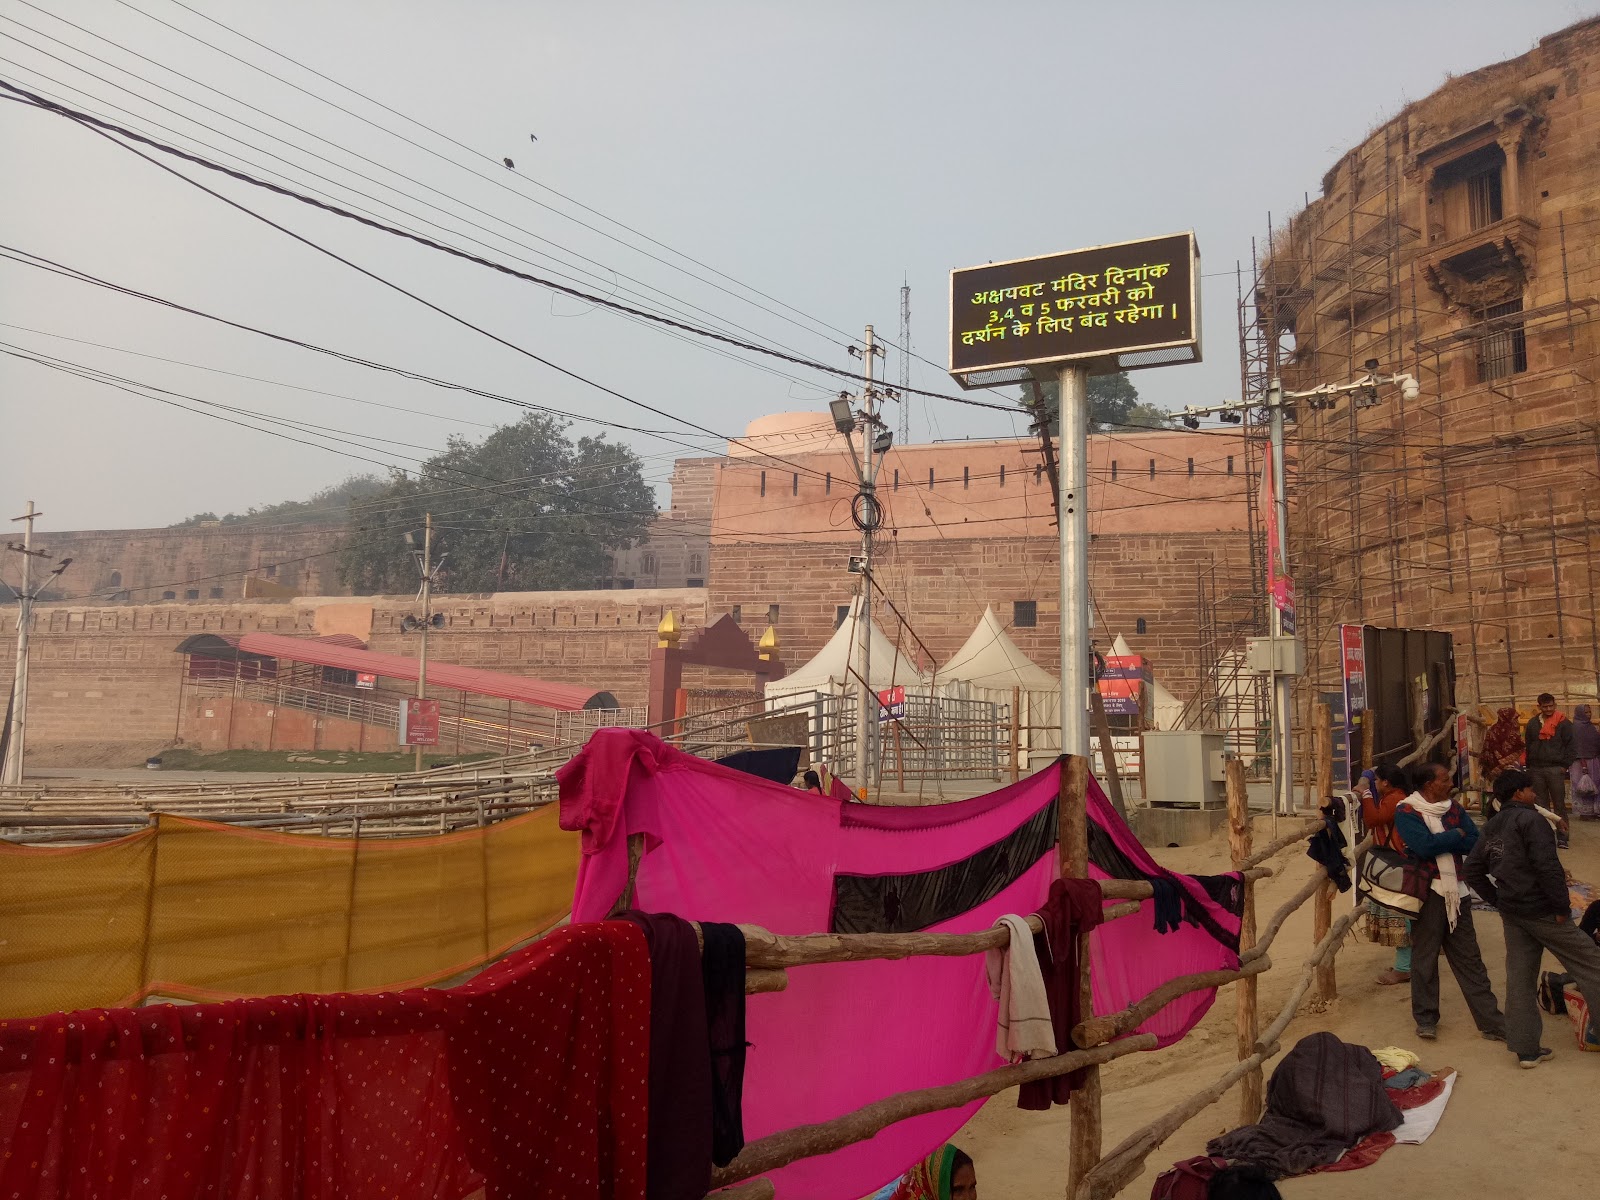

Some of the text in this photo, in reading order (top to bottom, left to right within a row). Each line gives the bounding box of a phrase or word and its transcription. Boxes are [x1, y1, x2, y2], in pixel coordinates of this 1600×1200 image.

[971, 264, 1170, 304] अक्षयवट मंदिर दिनांक
[988, 283, 1155, 323] 3,4 व 5 फरवरी को
[961, 324, 1006, 345] दर्शन
[1012, 320, 1031, 337] के
[1036, 316, 1074, 334] लिए
[1079, 311, 1108, 328] बंद
[1114, 304, 1164, 323] रहेगा
